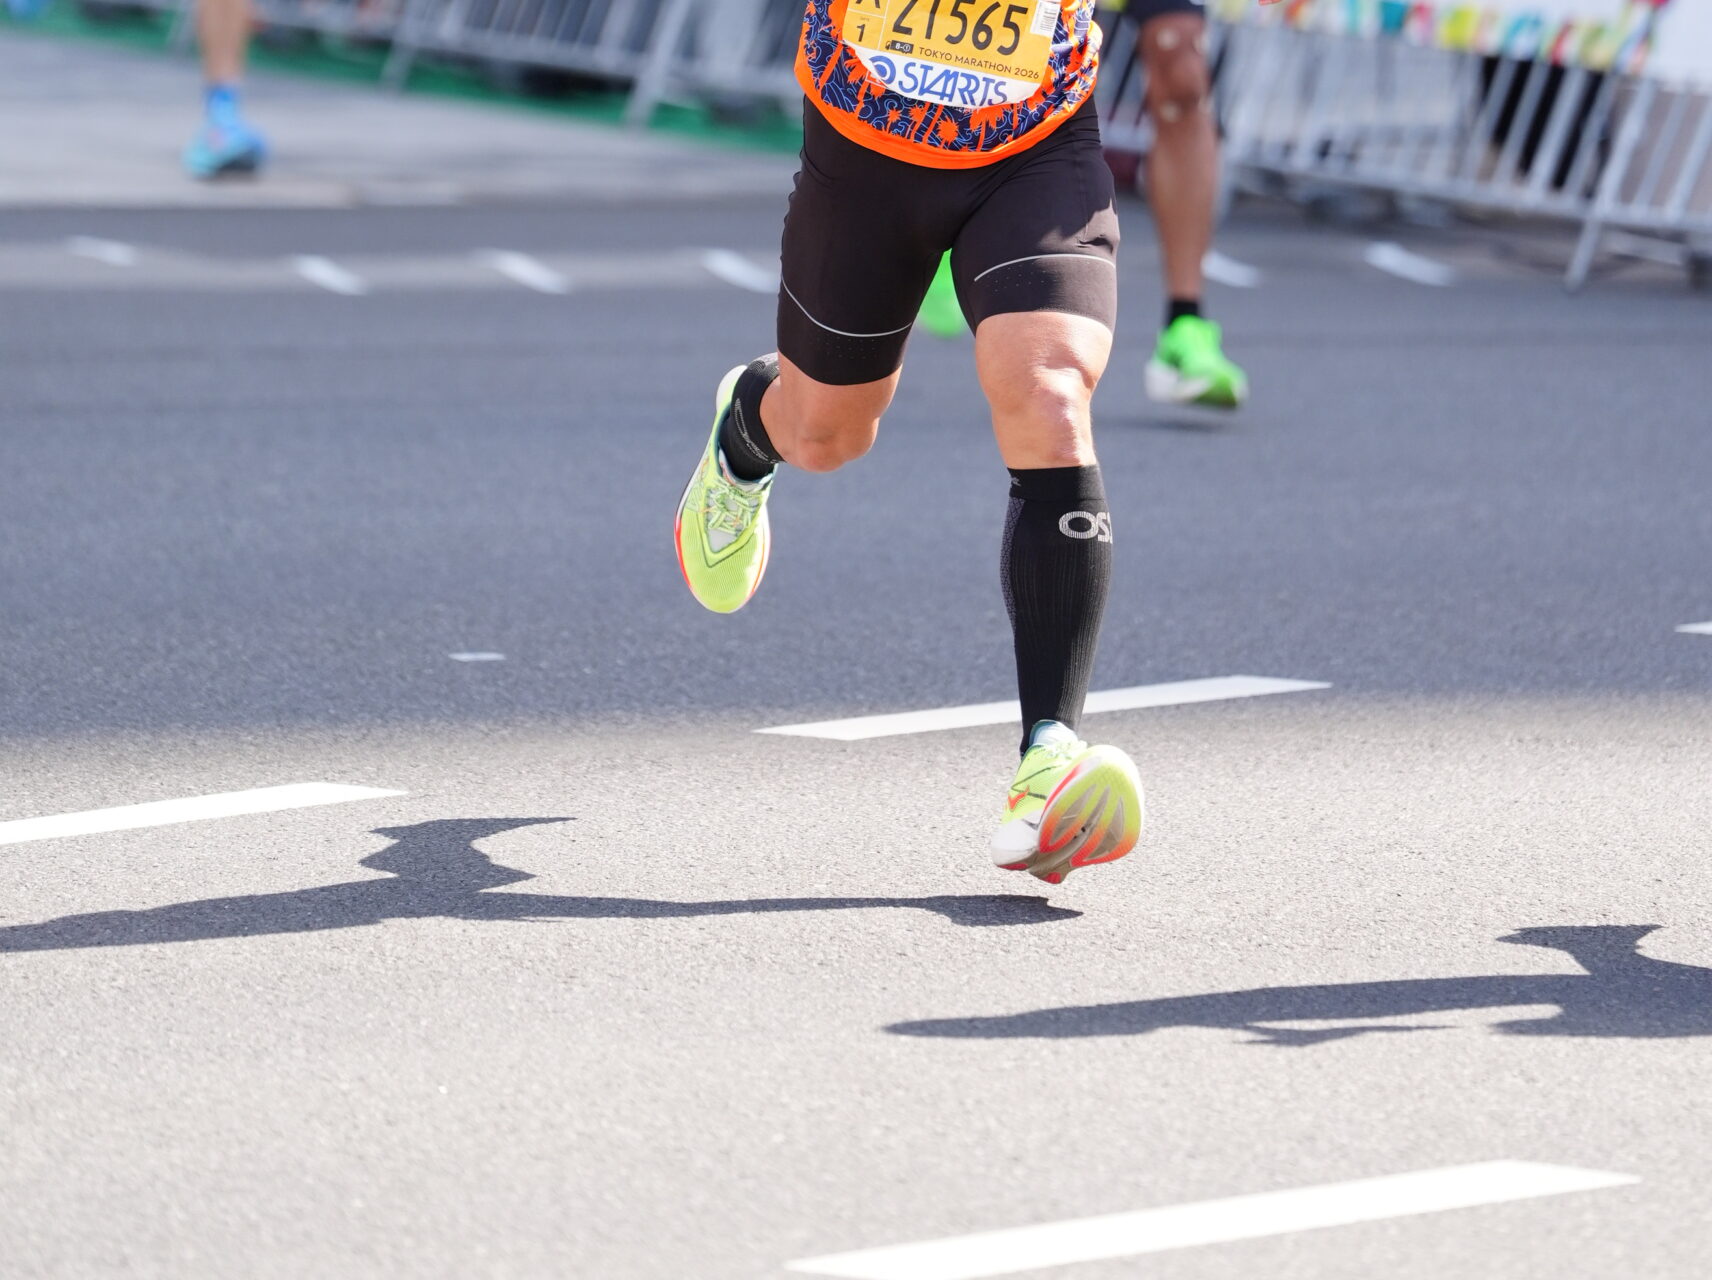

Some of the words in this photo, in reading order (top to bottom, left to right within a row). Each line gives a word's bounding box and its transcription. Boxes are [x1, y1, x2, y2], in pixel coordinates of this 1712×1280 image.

[856, 23, 866, 42] 1
[918, 46, 953, 62] TOKYO
[954, 54, 1012, 75] MARATHON
[1014, 66, 1040, 80] 2026
[1059, 510, 1112, 544] OS
